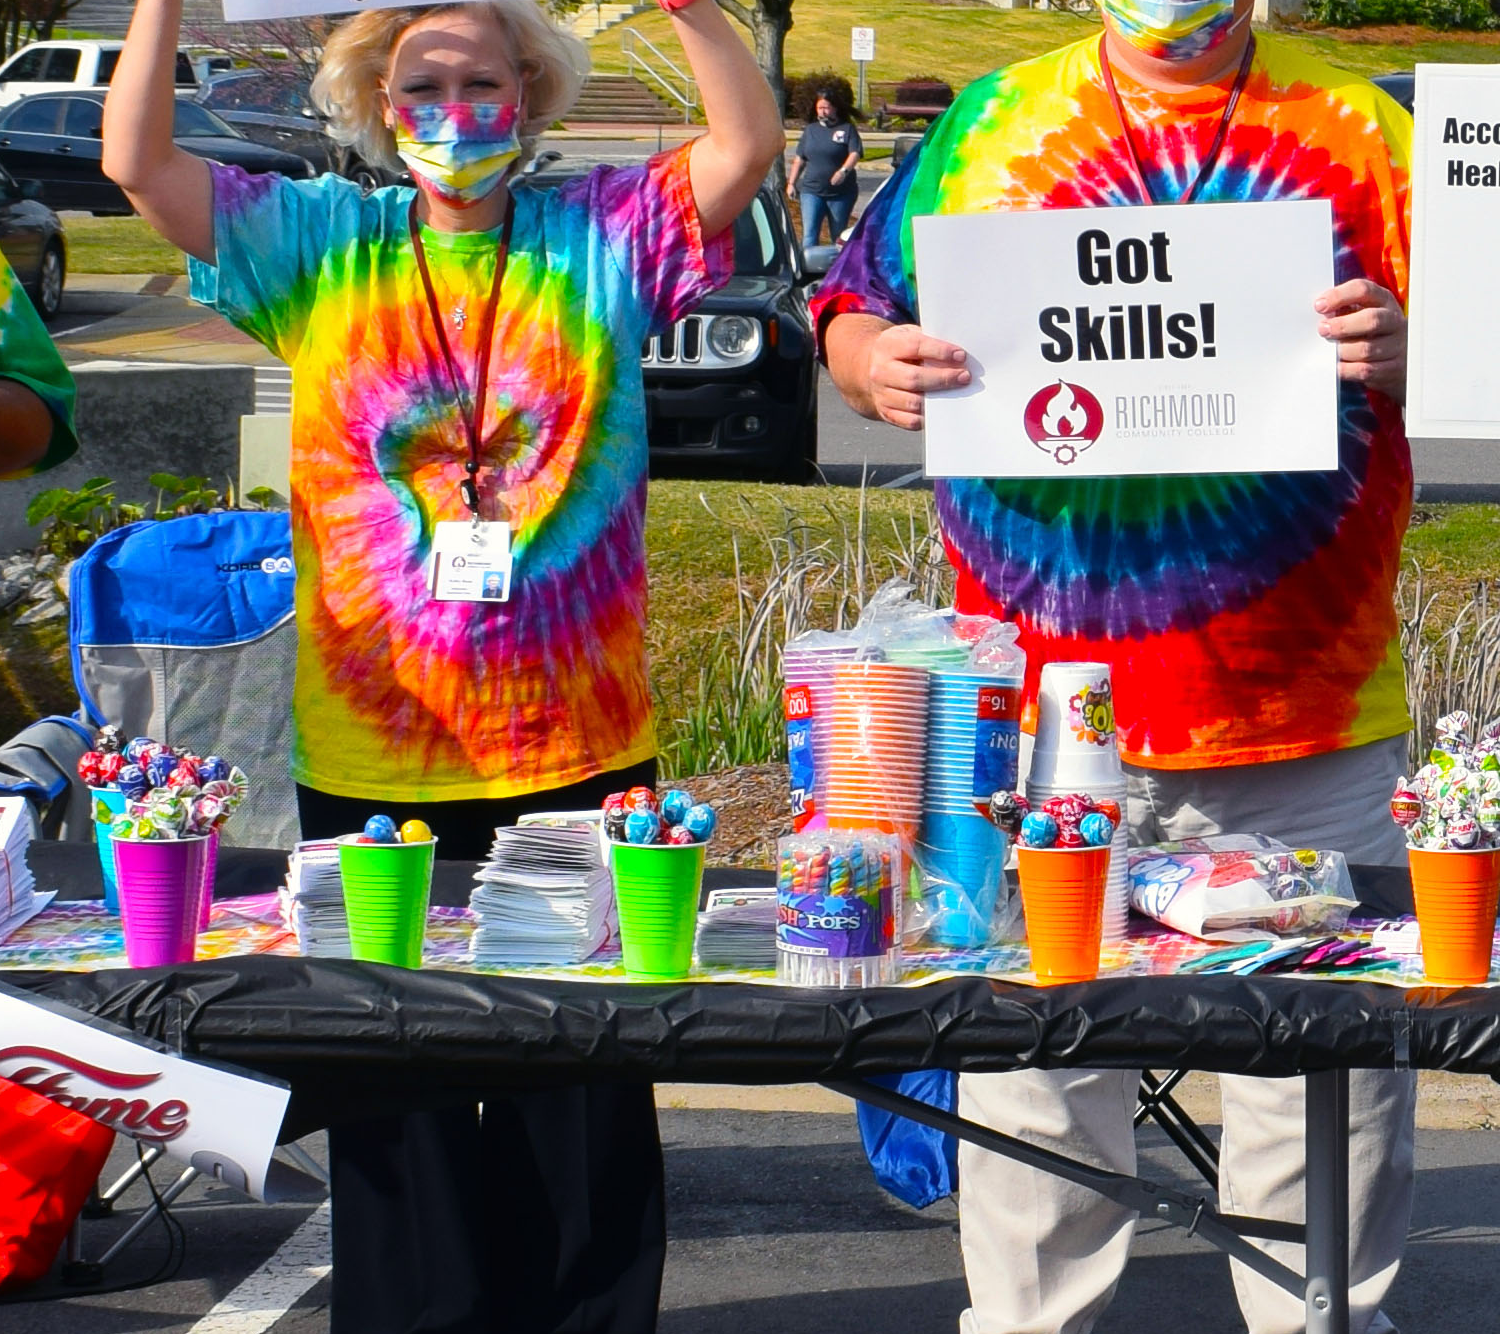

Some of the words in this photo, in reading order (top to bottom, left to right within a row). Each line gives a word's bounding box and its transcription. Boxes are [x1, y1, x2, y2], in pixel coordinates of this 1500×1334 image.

[1077, 229, 1172, 286] Got
[1040, 302, 1216, 363] Skills!
[1116, 393, 1236, 429] RICHMOND
[1116, 429, 1182, 438] COMMUNITY
[1187, 428, 1236, 436] COLLEGE
[789, 699, 808, 714] 100
[806, 915, 860, 929] POPS
